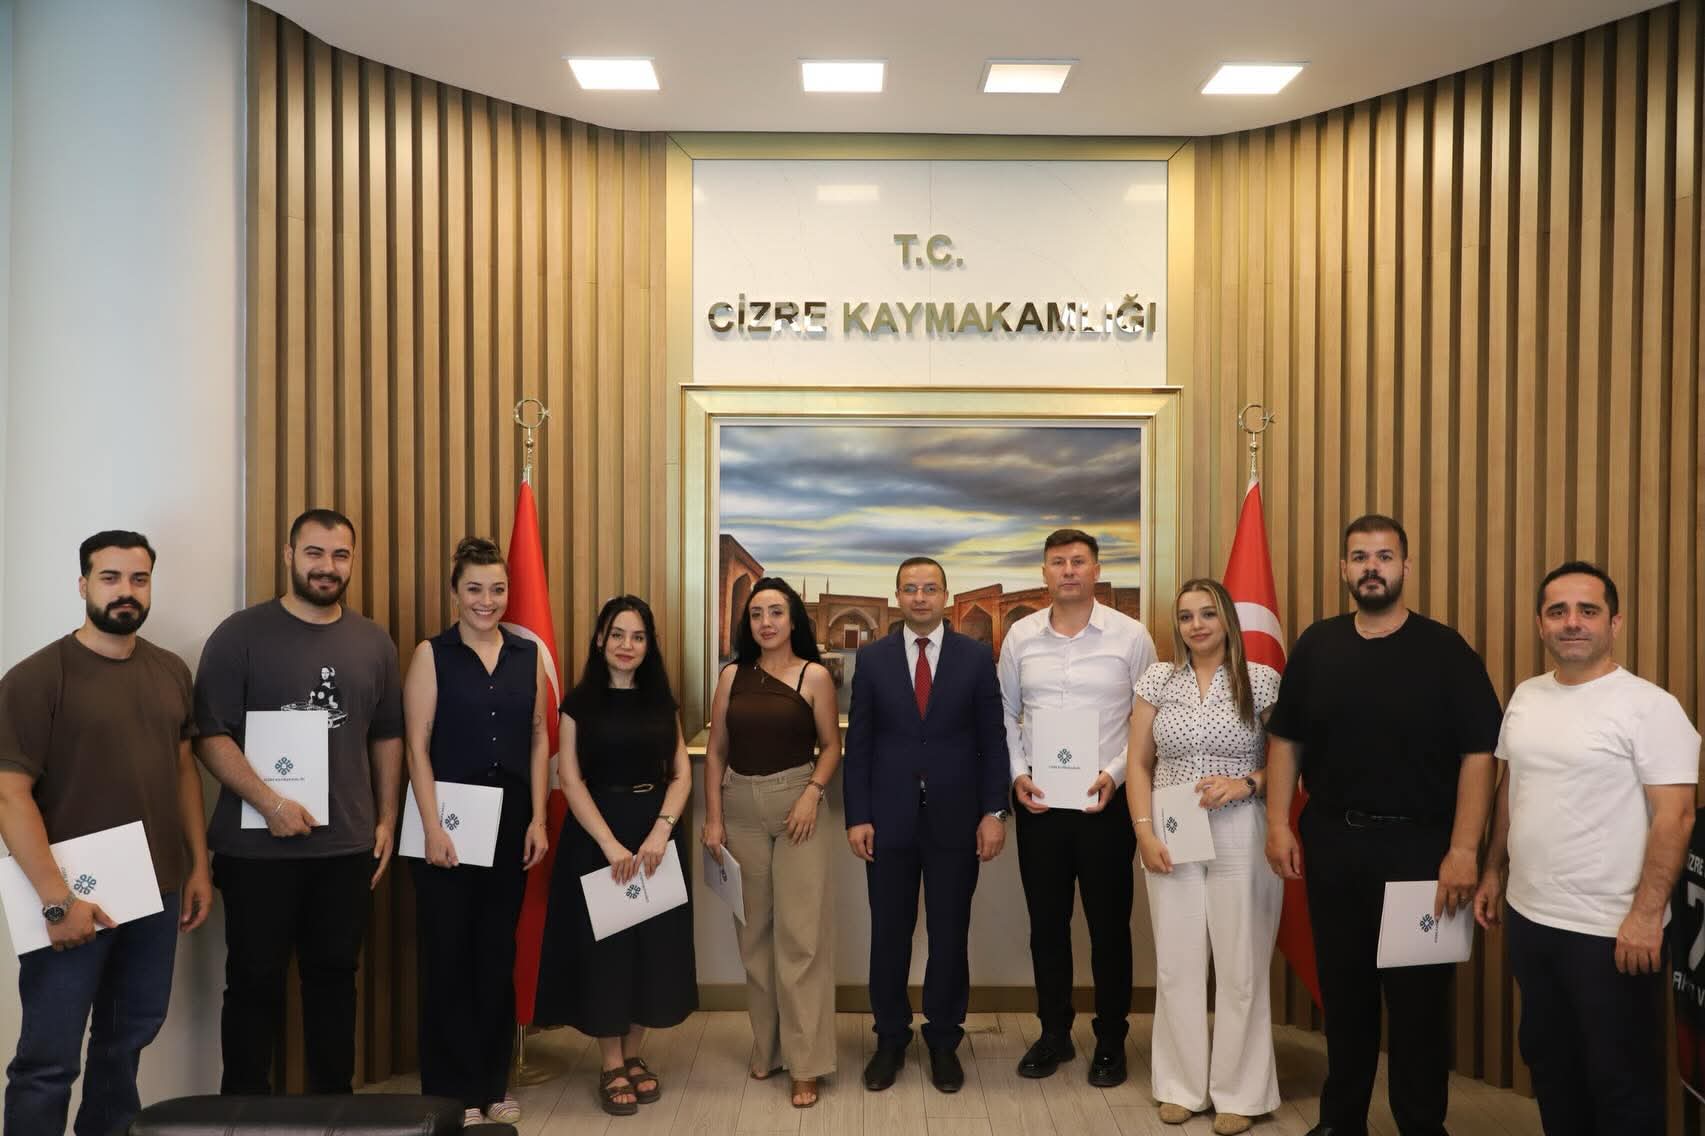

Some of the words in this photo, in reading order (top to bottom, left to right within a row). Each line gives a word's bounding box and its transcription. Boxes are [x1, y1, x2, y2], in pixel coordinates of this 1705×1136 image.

[893, 233, 963, 267] T.C.
[707, 293, 827, 334] CİZRE
[842, 293, 1156, 334] KAYMAKAMLIĞI
